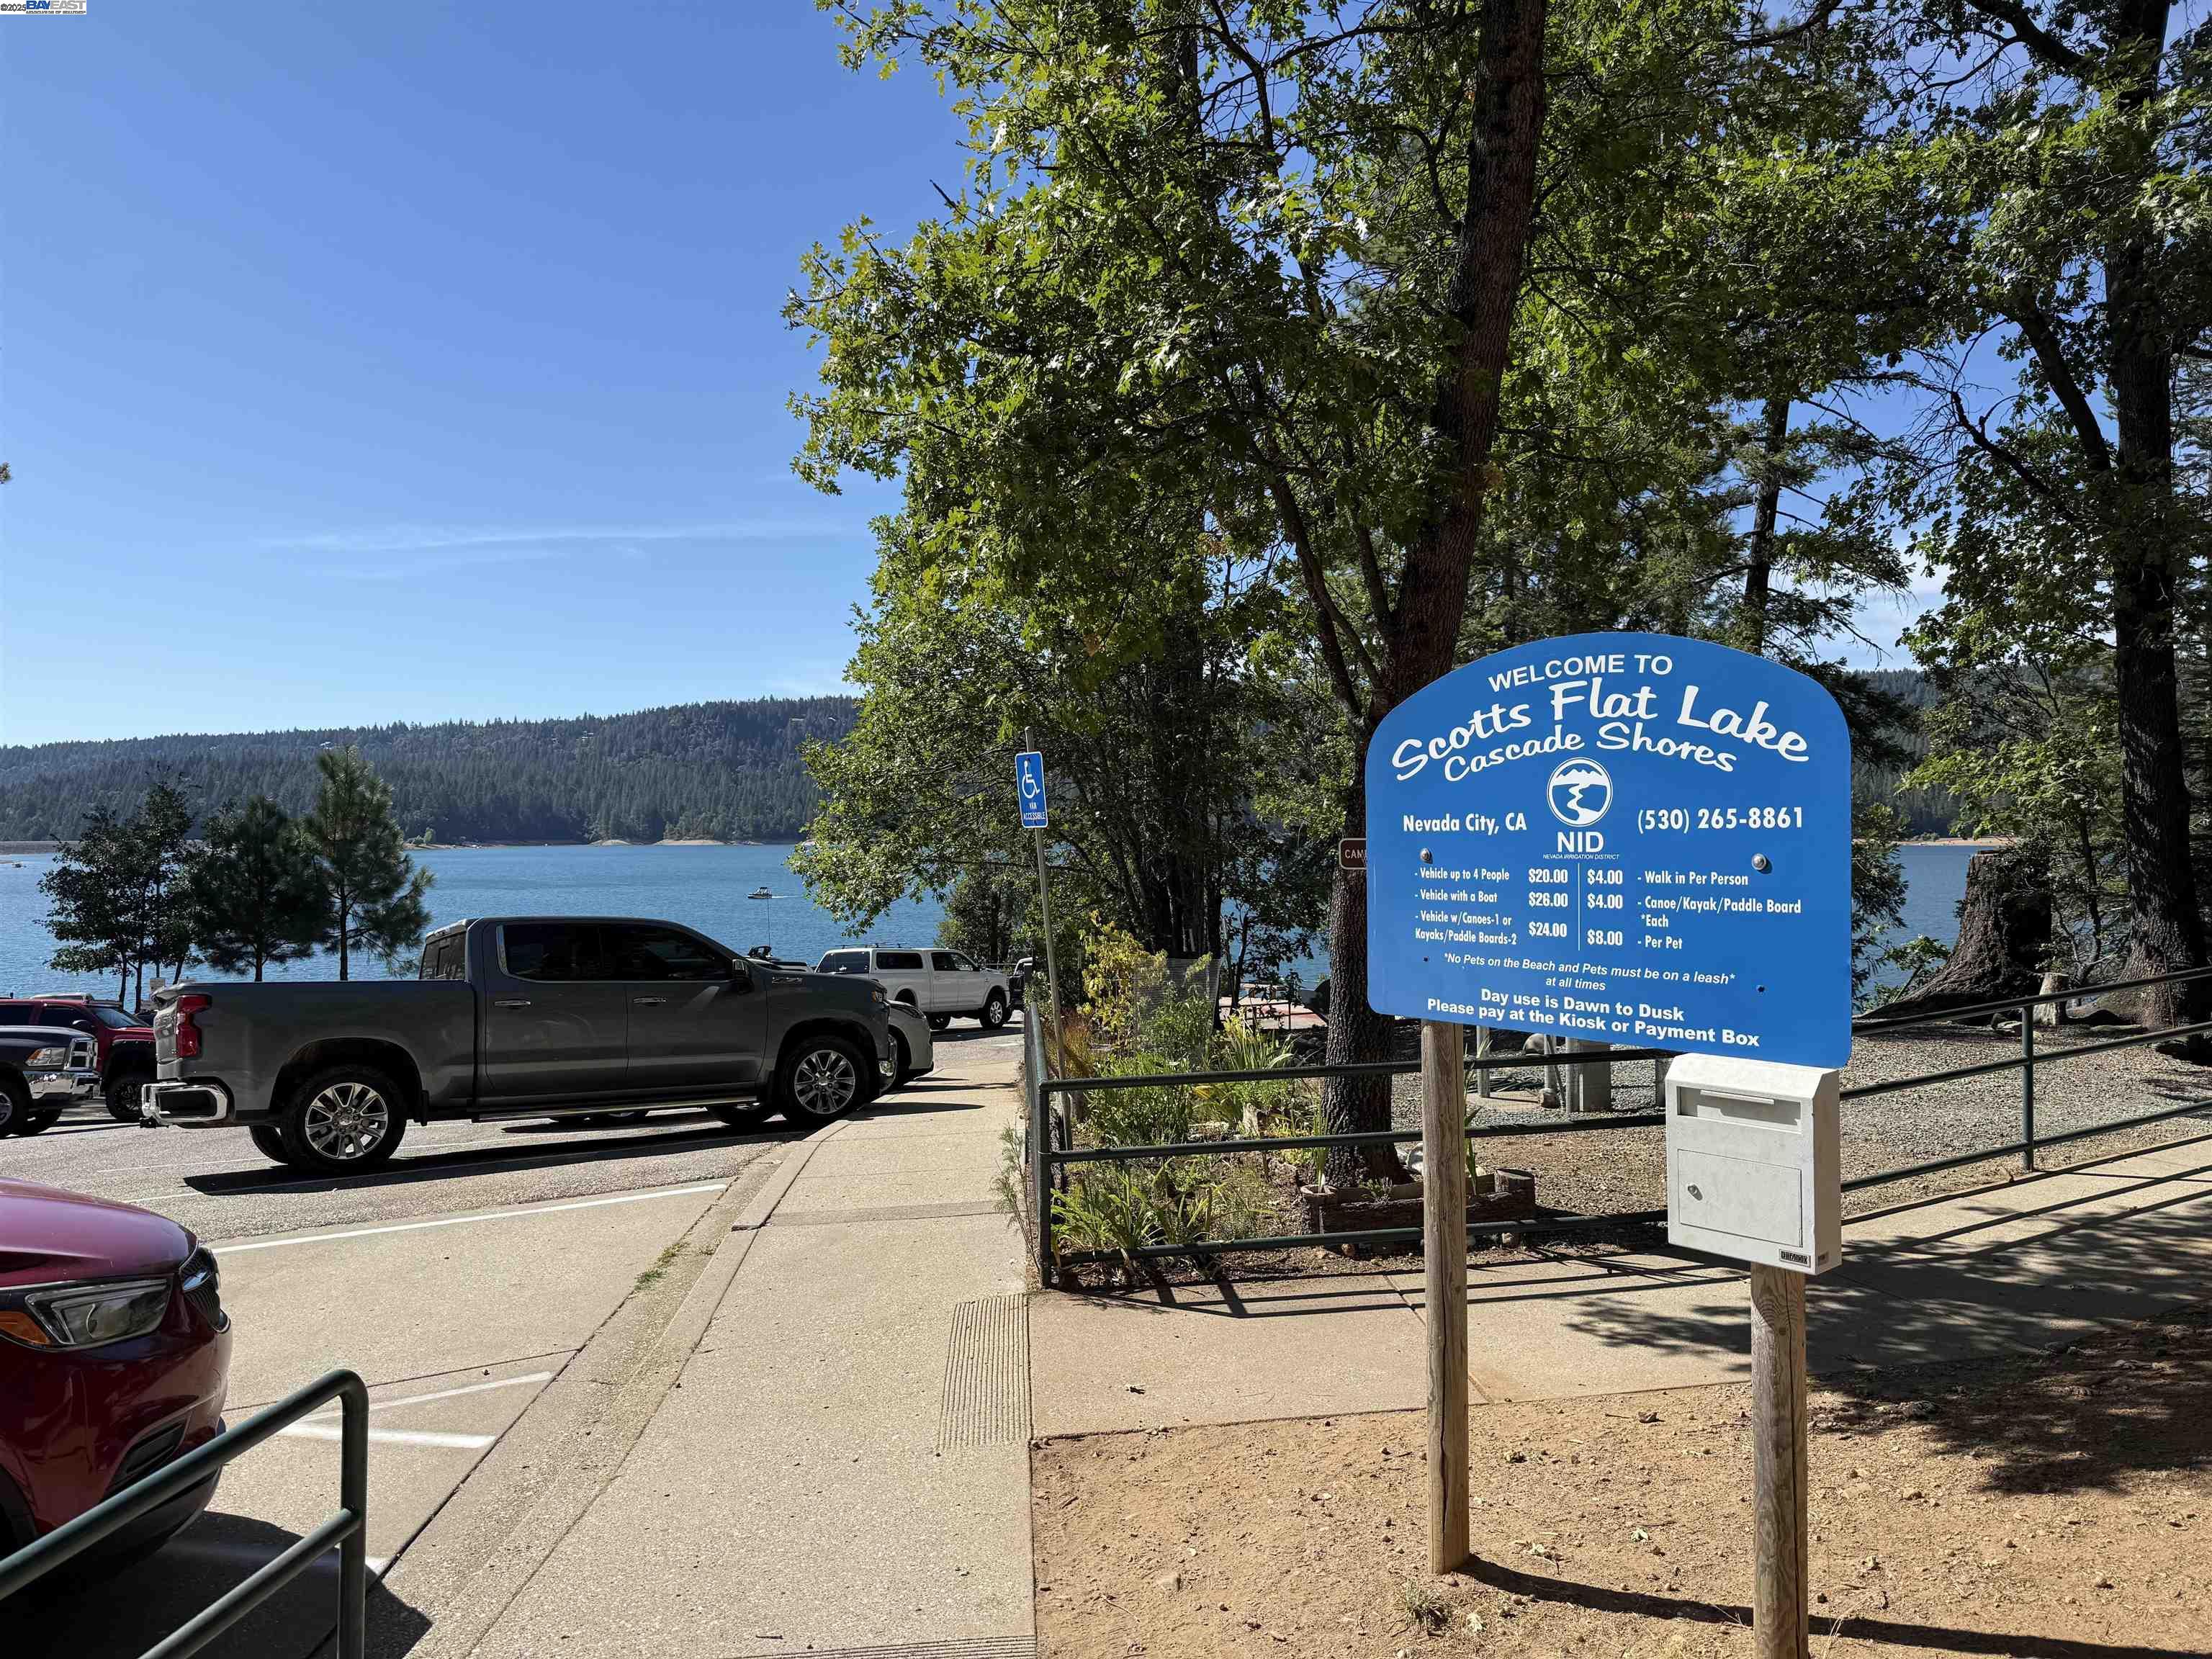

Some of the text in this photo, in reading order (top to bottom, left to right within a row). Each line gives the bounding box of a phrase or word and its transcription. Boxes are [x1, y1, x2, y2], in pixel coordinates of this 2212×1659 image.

[1488, 654, 1673, 693] WELCOME TO
[1391, 677, 1809, 782] Scotts Flat Lake
[1444, 721, 1737, 782] Cascade Shores
[1403, 812, 1527, 836] Nevada City, CA
[1638, 806, 1802, 835] (530) 265-8861
[1557, 831, 1604, 853] NID
[1420, 867, 1448, 879] Vehicle
[1450, 871, 1461, 882] up
[1462, 869, 1471, 880] to
[1473, 868, 1479, 880] 4
[1481, 868, 1510, 883] People
[1528, 868, 1568, 884] $20.00
[1587, 868, 1623, 886] $4.00
[1645, 870, 1672, 884] Walk
[1675, 871, 1686, 884] in
[1689, 871, 1707, 885] Per
[1710, 871, 1748, 886] Person
[1420, 888, 1449, 901] Vehicle
[1450, 889, 1468, 902] with
[1470, 893, 1476, 902] a
[1478, 890, 1498, 903] Boat
[1528, 891, 1568, 907] $26.00
[1587, 892, 1623, 909] $4.00
[1645, 895, 1763, 914] Canoe/Kayak/Paddle
[1766, 899, 1802, 914] Board
[1420, 909, 1449, 922] Vehicle
[1450, 912, 1499, 926] w/Canoes-1
[1502, 917, 1512, 926] or
[1415, 927, 1517, 945] Kayaks/Paddle Boards-2
[1528, 921, 1568, 938] $24.00
[1587, 928, 1623, 946] $8.00
[1645, 935, 1663, 948] Per
[1665, 935, 1683, 949] Pet
[1463, 954, 1485, 966] Pets
[1488, 958, 1501, 967] on
[1503, 957, 1520, 968] the
[1521, 958, 1556, 971] Beach
[1558, 963, 1580, 973] and
[1582, 963, 1608, 975] Pets
[1611, 968, 1642, 978] must
[1644, 967, 1660, 979] be
[1663, 971, 1679, 981] on
[1682, 973, 1690, 981] a
[1545, 976, 1606, 991] at all times
[1481, 988, 1685, 1021] Day use is Dawn to Dusk
[1427, 998, 1760, 1047] Please pay at the Kiosk or Payment Box
